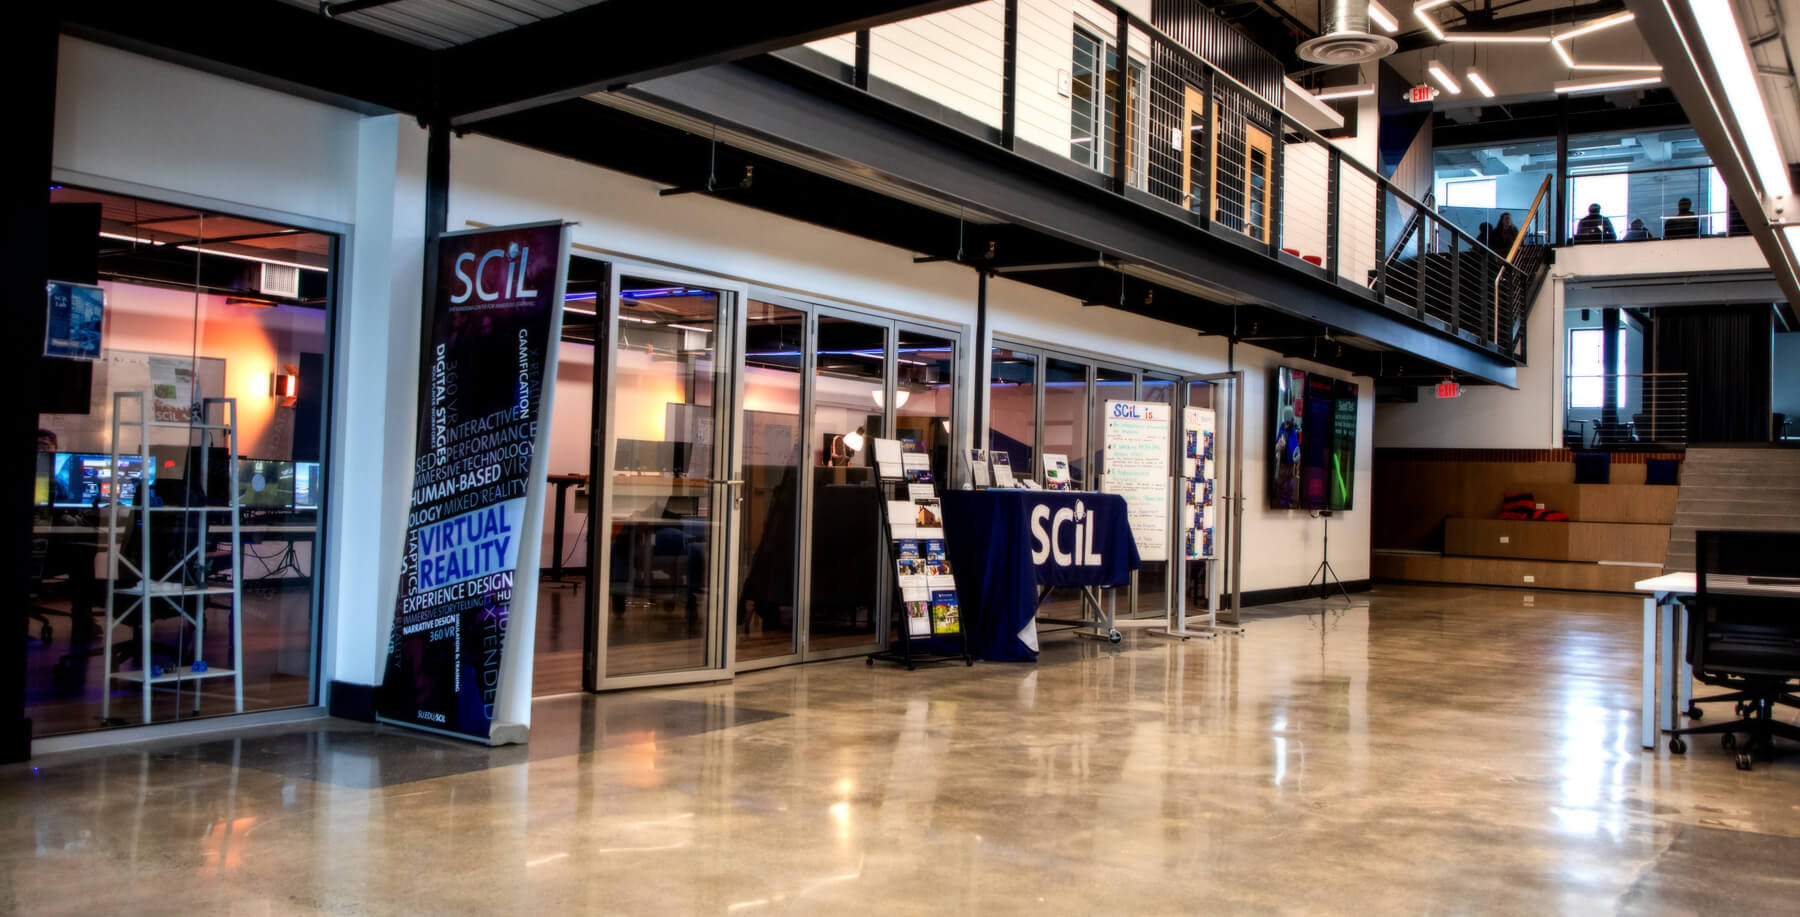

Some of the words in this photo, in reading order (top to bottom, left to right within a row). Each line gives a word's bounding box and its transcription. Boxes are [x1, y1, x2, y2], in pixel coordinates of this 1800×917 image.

[1413, 88, 1429, 101] EXIT
[450, 242, 538, 304] SCiL
[436, 343, 446, 406] DIGITAL
[519, 328, 530, 419] GAMIFICATION
[1439, 384, 1456, 398] EXIT
[446, 398, 458, 425] VR
[446, 405, 520, 443] INTERACTIVE
[436, 407, 447, 466] STAGES
[446, 421, 537, 461] PERFORMANCE
[462, 440, 537, 472] TECHNOLOGY
[409, 504, 443, 528] OLOGY
[443, 491, 479, 516] MIXED
[480, 478, 529, 504] REALITY
[411, 463, 502, 507] HUMAN-BASED
[420, 505, 511, 556] VIRTUAL
[1031, 499, 1102, 567] SCiL
[408, 529, 418, 596] HAPTICS
[420, 536, 511, 589] REALITY
[403, 582, 465, 614] EXPERIENCE
[468, 571, 513, 597] DESIGN
[403, 608, 438, 624] IMMERSIVE
[438, 597, 484, 615] STORYTELLING
[402, 620, 435, 636] NARRATIVE
[434, 614, 456, 628] DESIGN
[429, 630, 444, 642] 360
[444, 626, 455, 639] VR
[483, 593, 498, 720] EXTENDED
